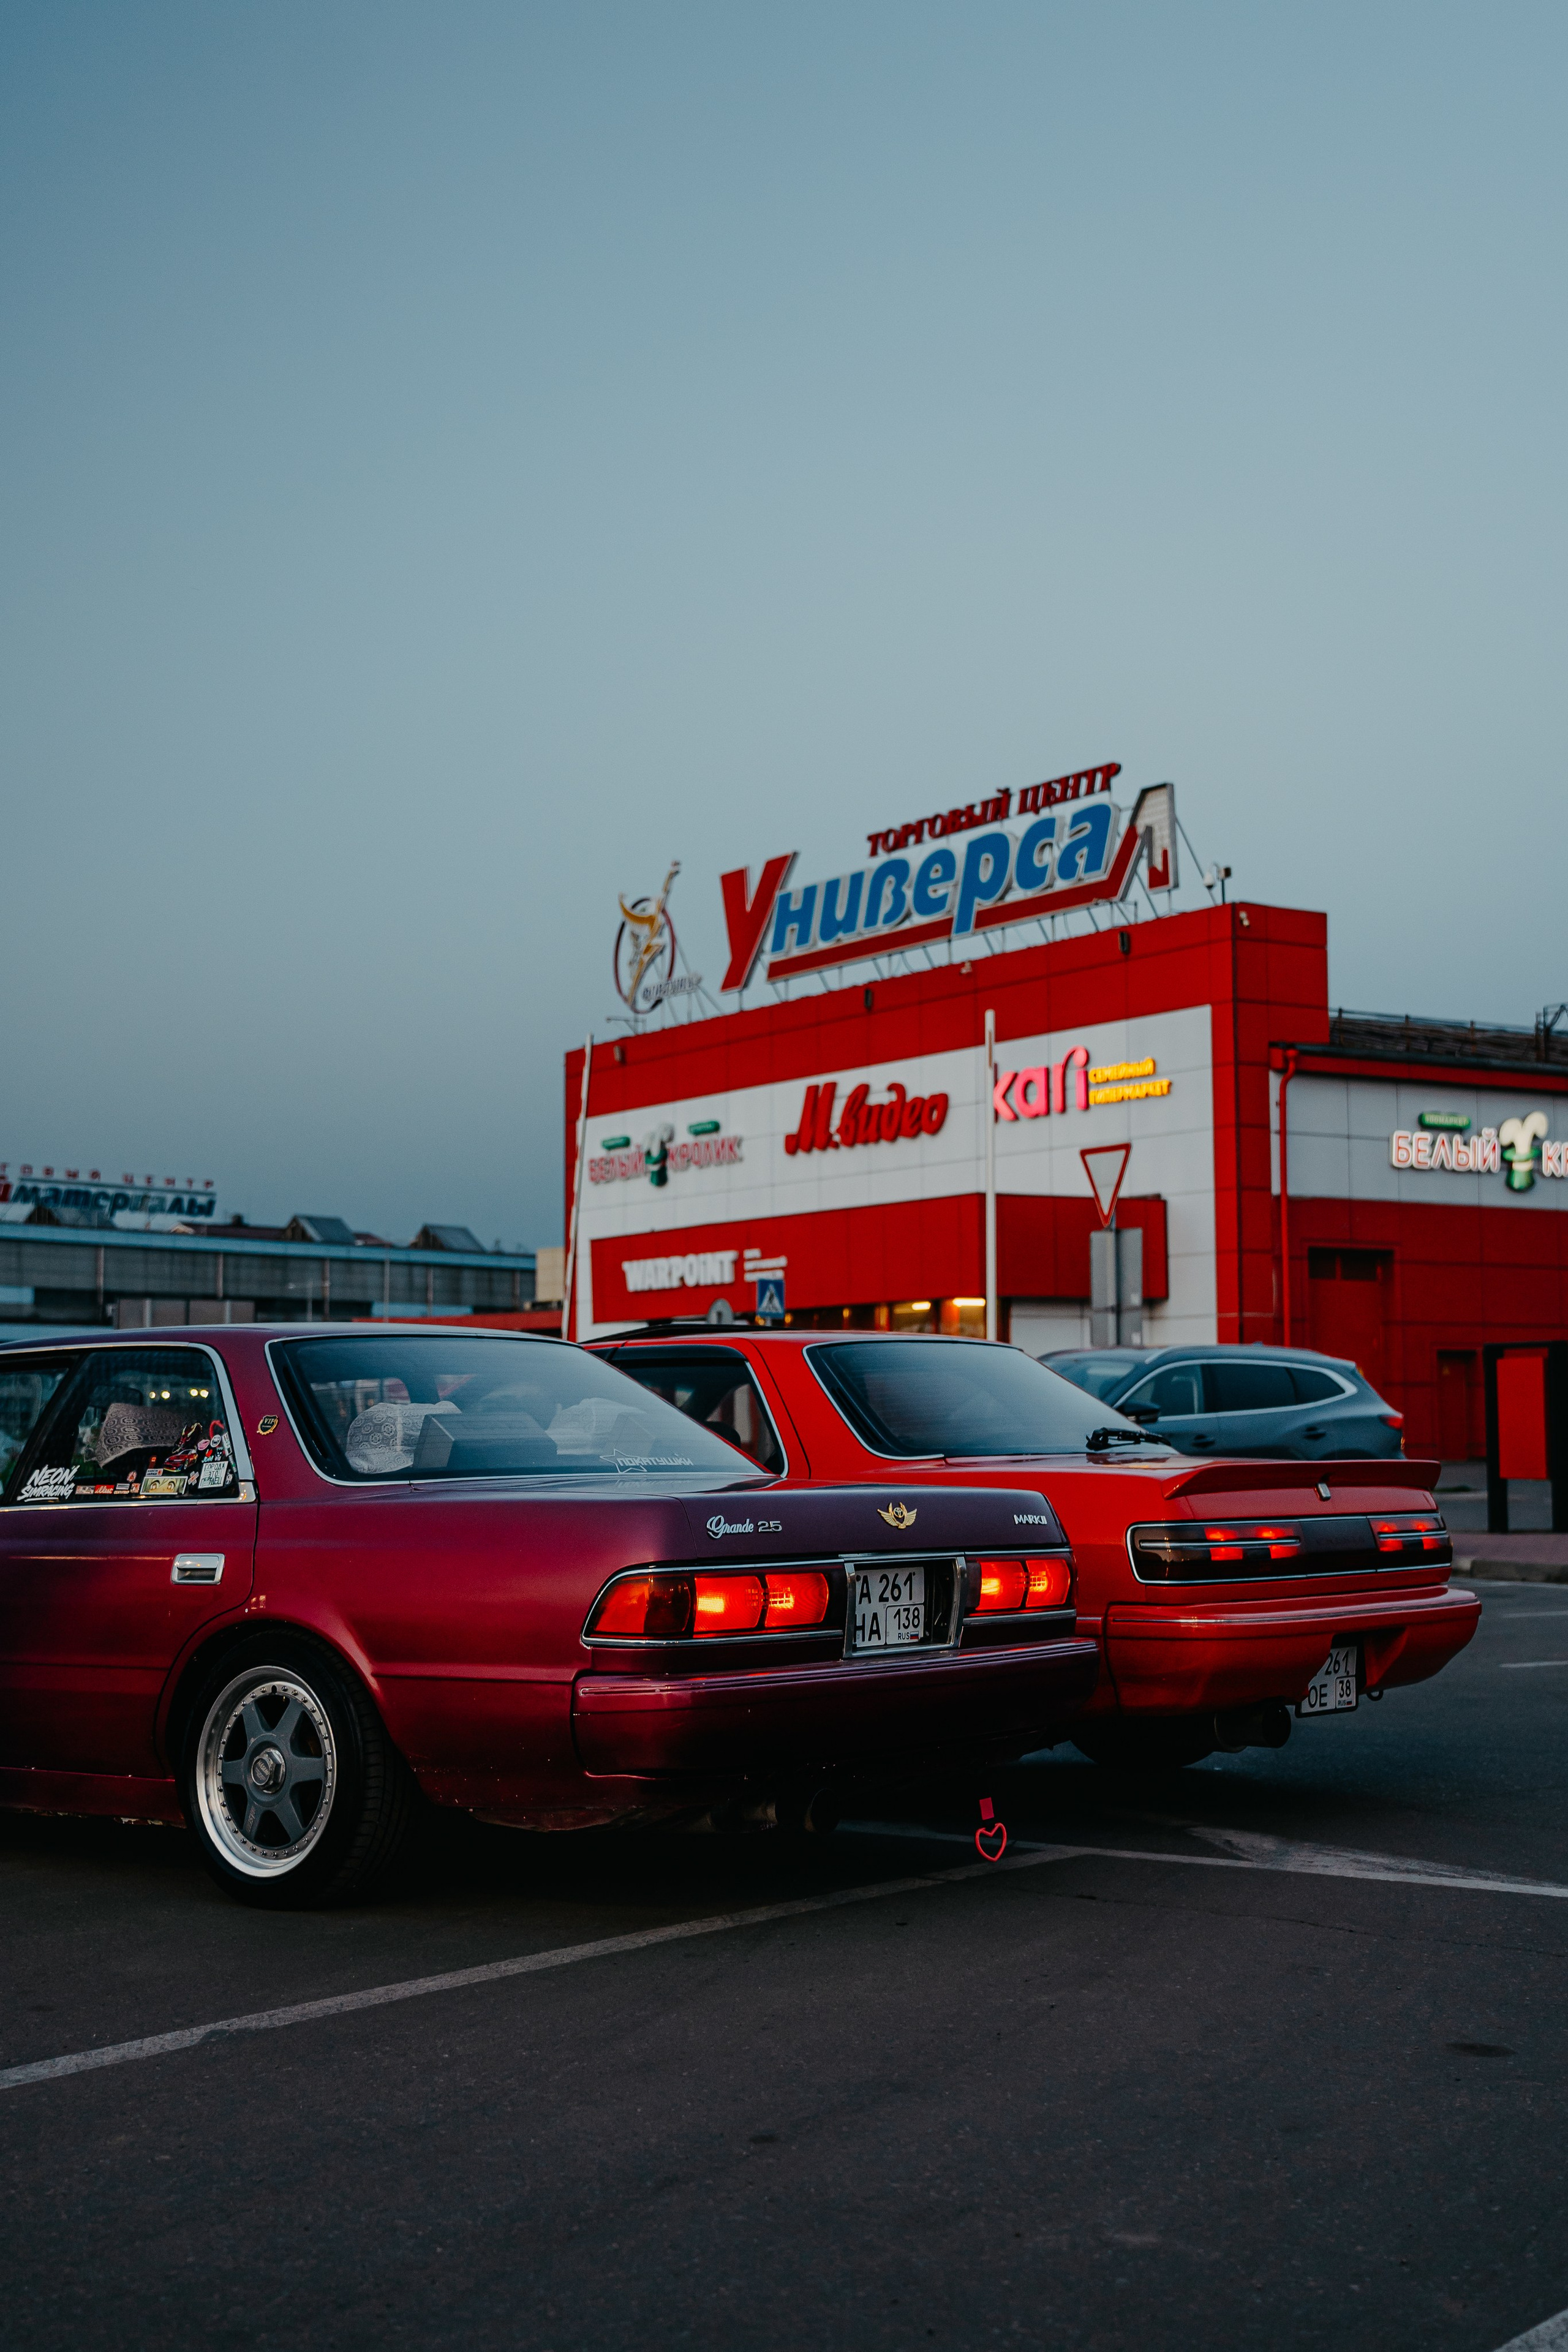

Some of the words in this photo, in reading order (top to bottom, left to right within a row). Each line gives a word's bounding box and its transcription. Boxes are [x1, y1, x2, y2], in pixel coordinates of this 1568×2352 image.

[867, 787, 1012, 857] ТОРГОВЫЙ
[1017, 762, 1121, 816] ЦЕНТР
[993, 1045, 1089, 1123] kari
[666, 1135, 744, 1172] КРОЛИК
[1392, 1126, 1501, 1174] БЕЛЫЙ
[616, 1456, 695, 1466] ПОКАТУШКИ
[26, 1464, 80, 1487] NEON
[17, 1483, 75, 1501] SIMRACING
[706, 1515, 754, 1539] Grande
[878, 1571, 913, 1603] 261
[893, 1607, 921, 1630] 138
[897, 1632, 910, 1640] RUS
[1325, 1650, 1349, 1675] 261
[1339, 1679, 1352, 1698] 38
